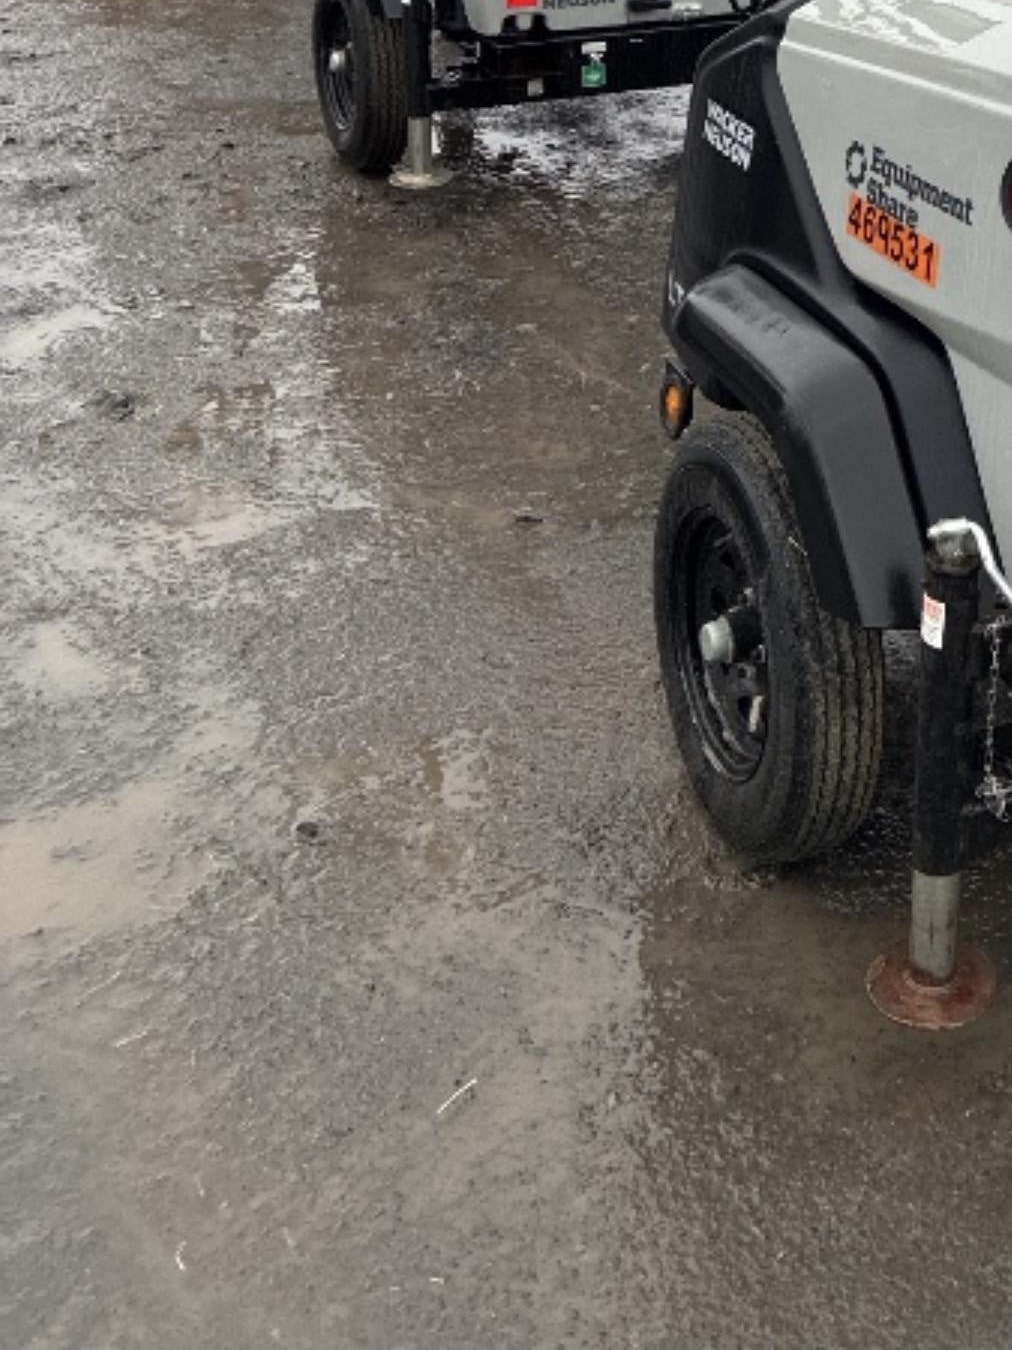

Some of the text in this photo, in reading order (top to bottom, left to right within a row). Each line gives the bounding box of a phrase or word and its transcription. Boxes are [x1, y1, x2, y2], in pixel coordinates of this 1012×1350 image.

[866, 176, 919, 228] Share
[870, 145, 974, 227] Equipment
[847, 197, 937, 285] 469531
